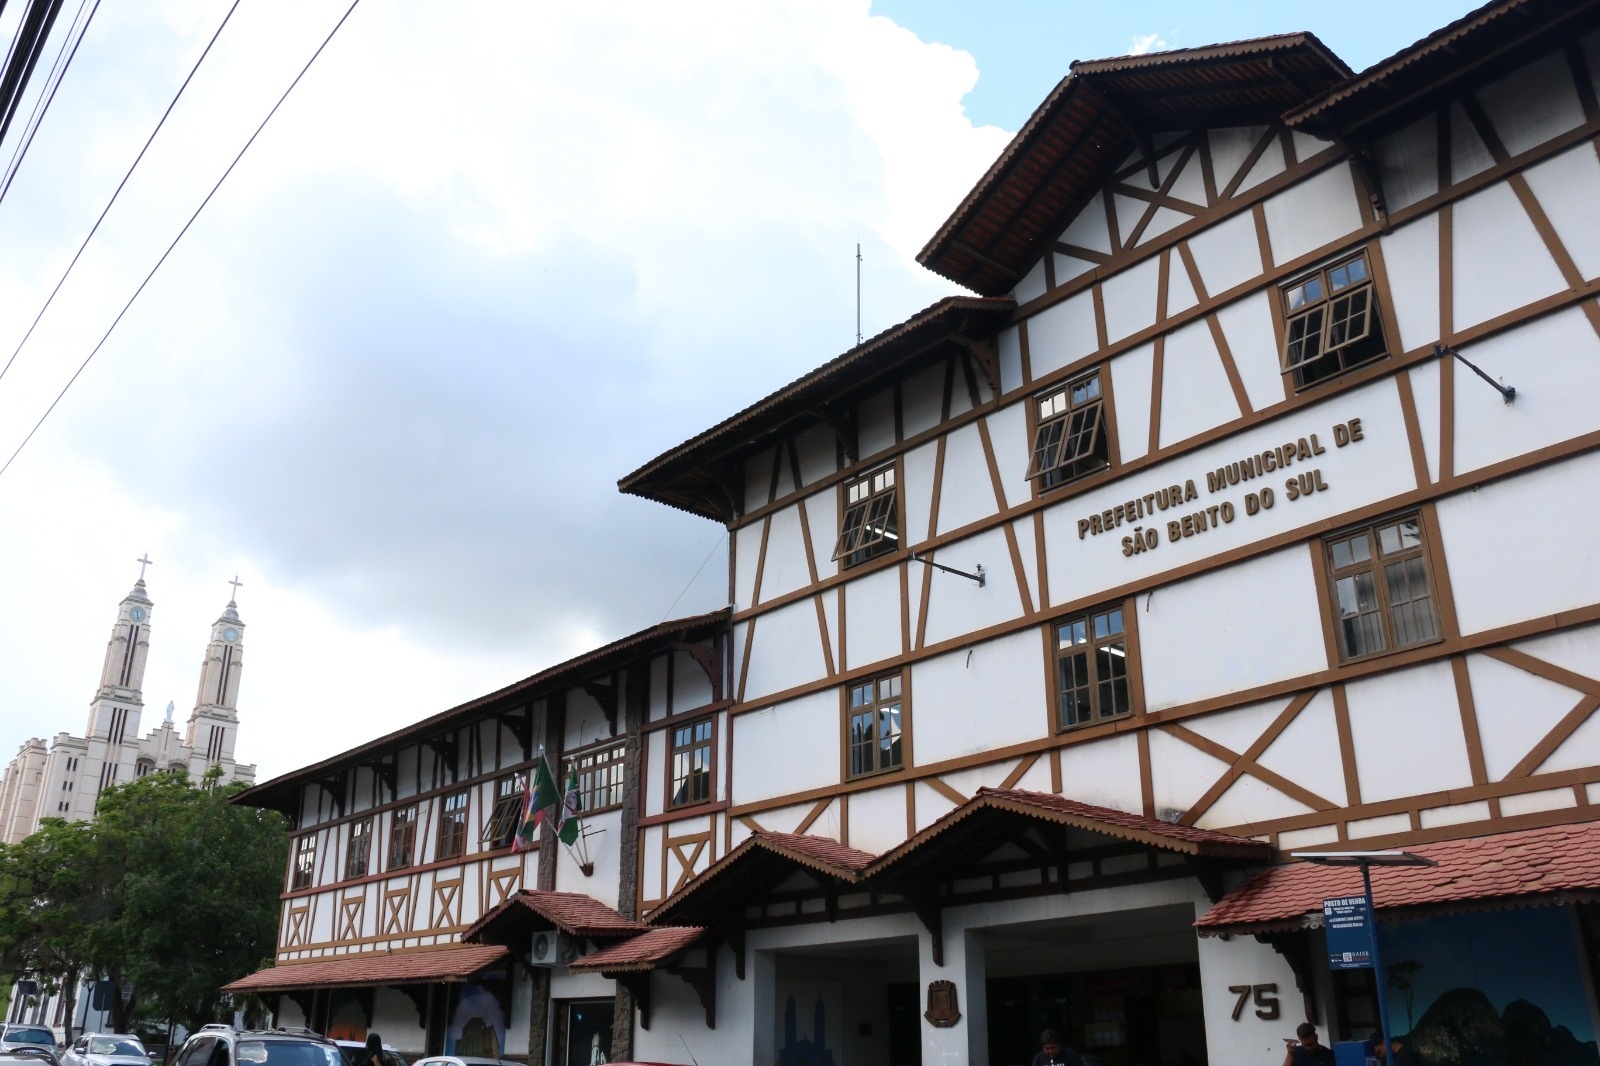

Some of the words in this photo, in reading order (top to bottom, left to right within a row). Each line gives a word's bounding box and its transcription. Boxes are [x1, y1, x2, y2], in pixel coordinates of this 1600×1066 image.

[1077, 479, 1198, 539] PREFEITURA
[1206, 434, 1325, 493] MUNICIPAL
[1332, 418, 1364, 447] DE
[1121, 526, 1158, 557] SÃO
[1167, 501, 1234, 542] BENTO
[1245, 487, 1275, 516] DO
[1285, 469, 1328, 501] SUL
[1228, 983, 1280, 1022] 75
